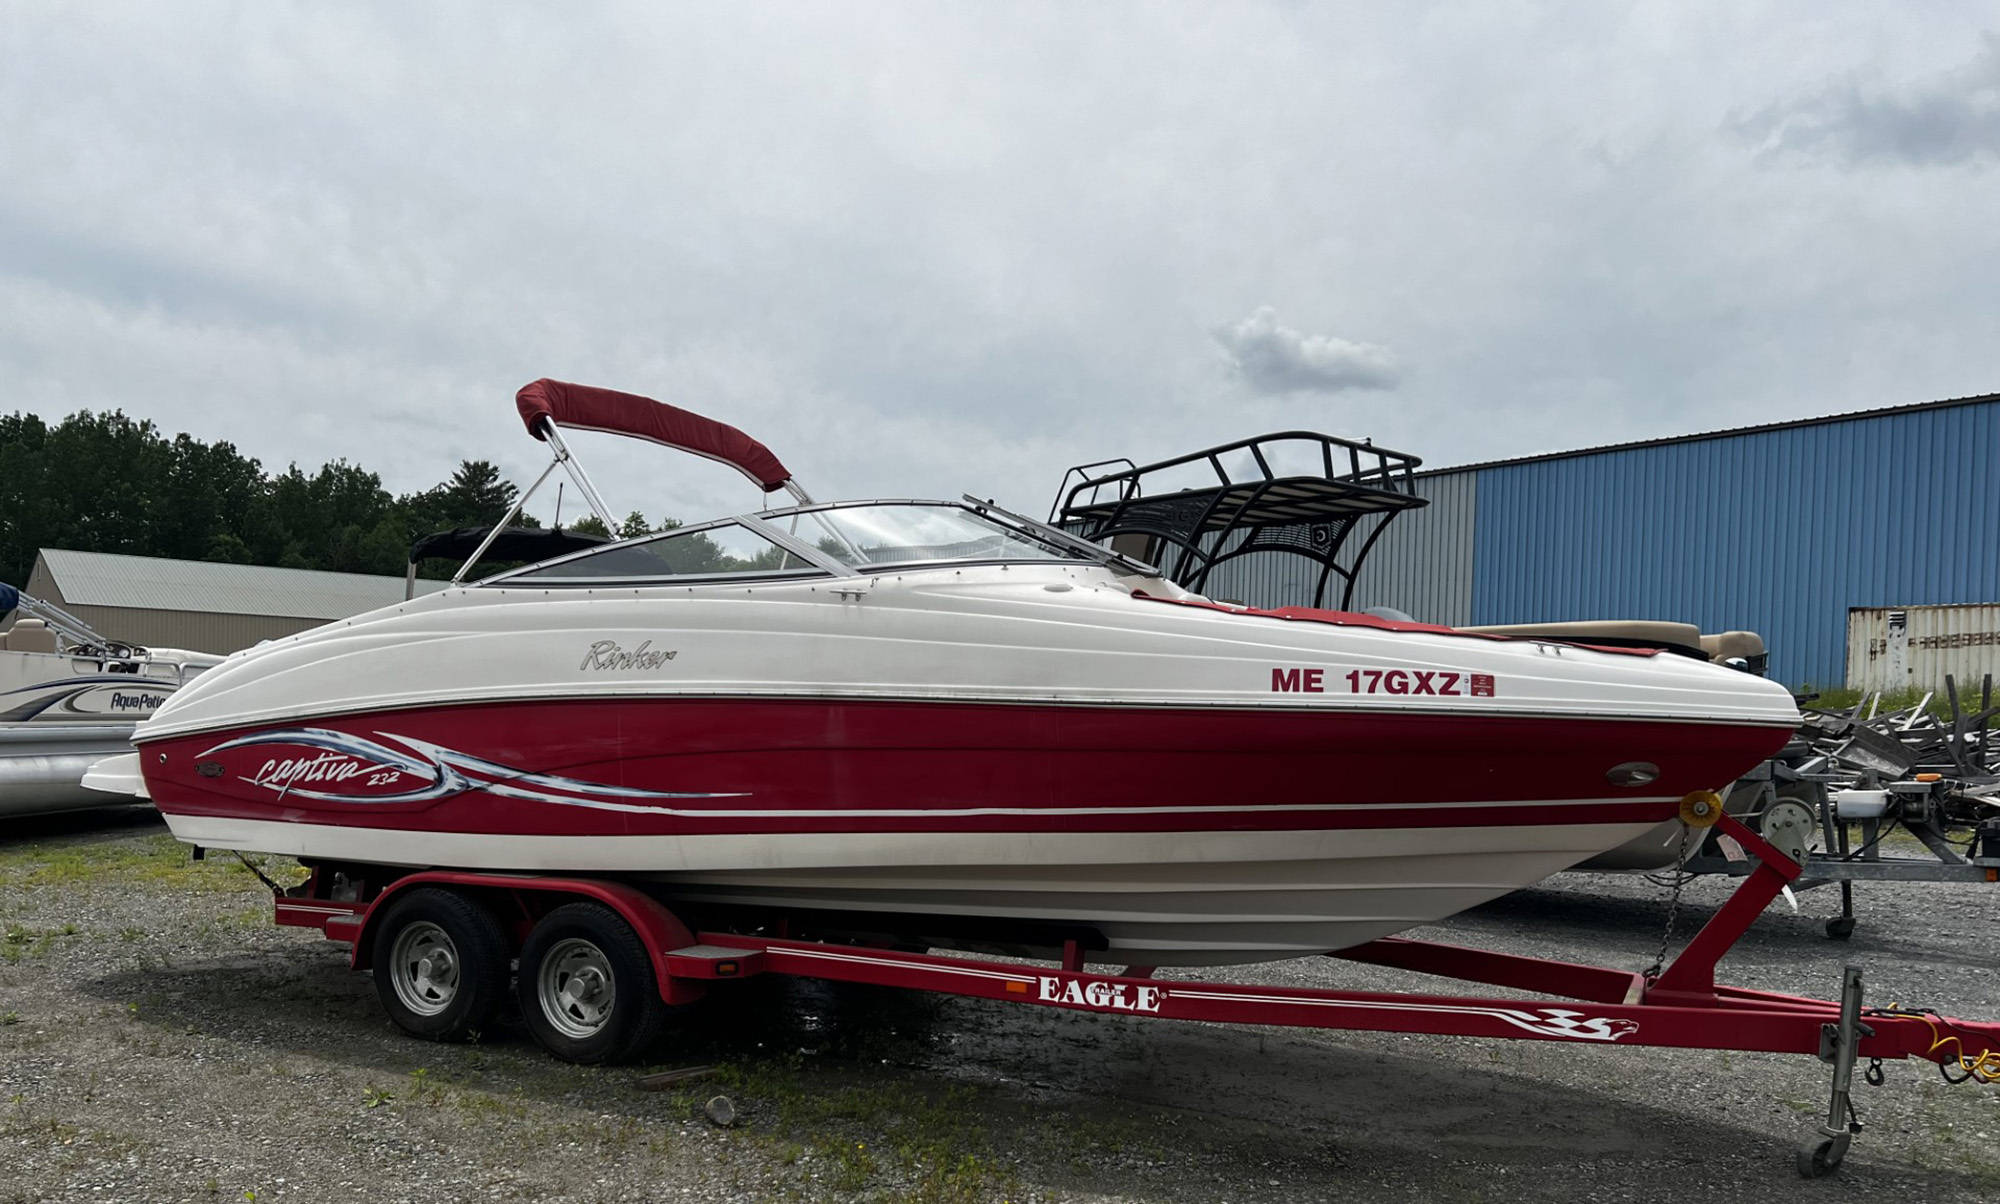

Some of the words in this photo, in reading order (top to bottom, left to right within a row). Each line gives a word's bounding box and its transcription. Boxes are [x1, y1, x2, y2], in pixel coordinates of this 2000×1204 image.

[580, 639, 677, 671] Rinker
[1271, 668, 1324, 693] ME
[1345, 669, 1461, 696] 17GXZ
[366, 771, 401, 786] 232
[1038, 976, 1161, 1013] EAGLE
